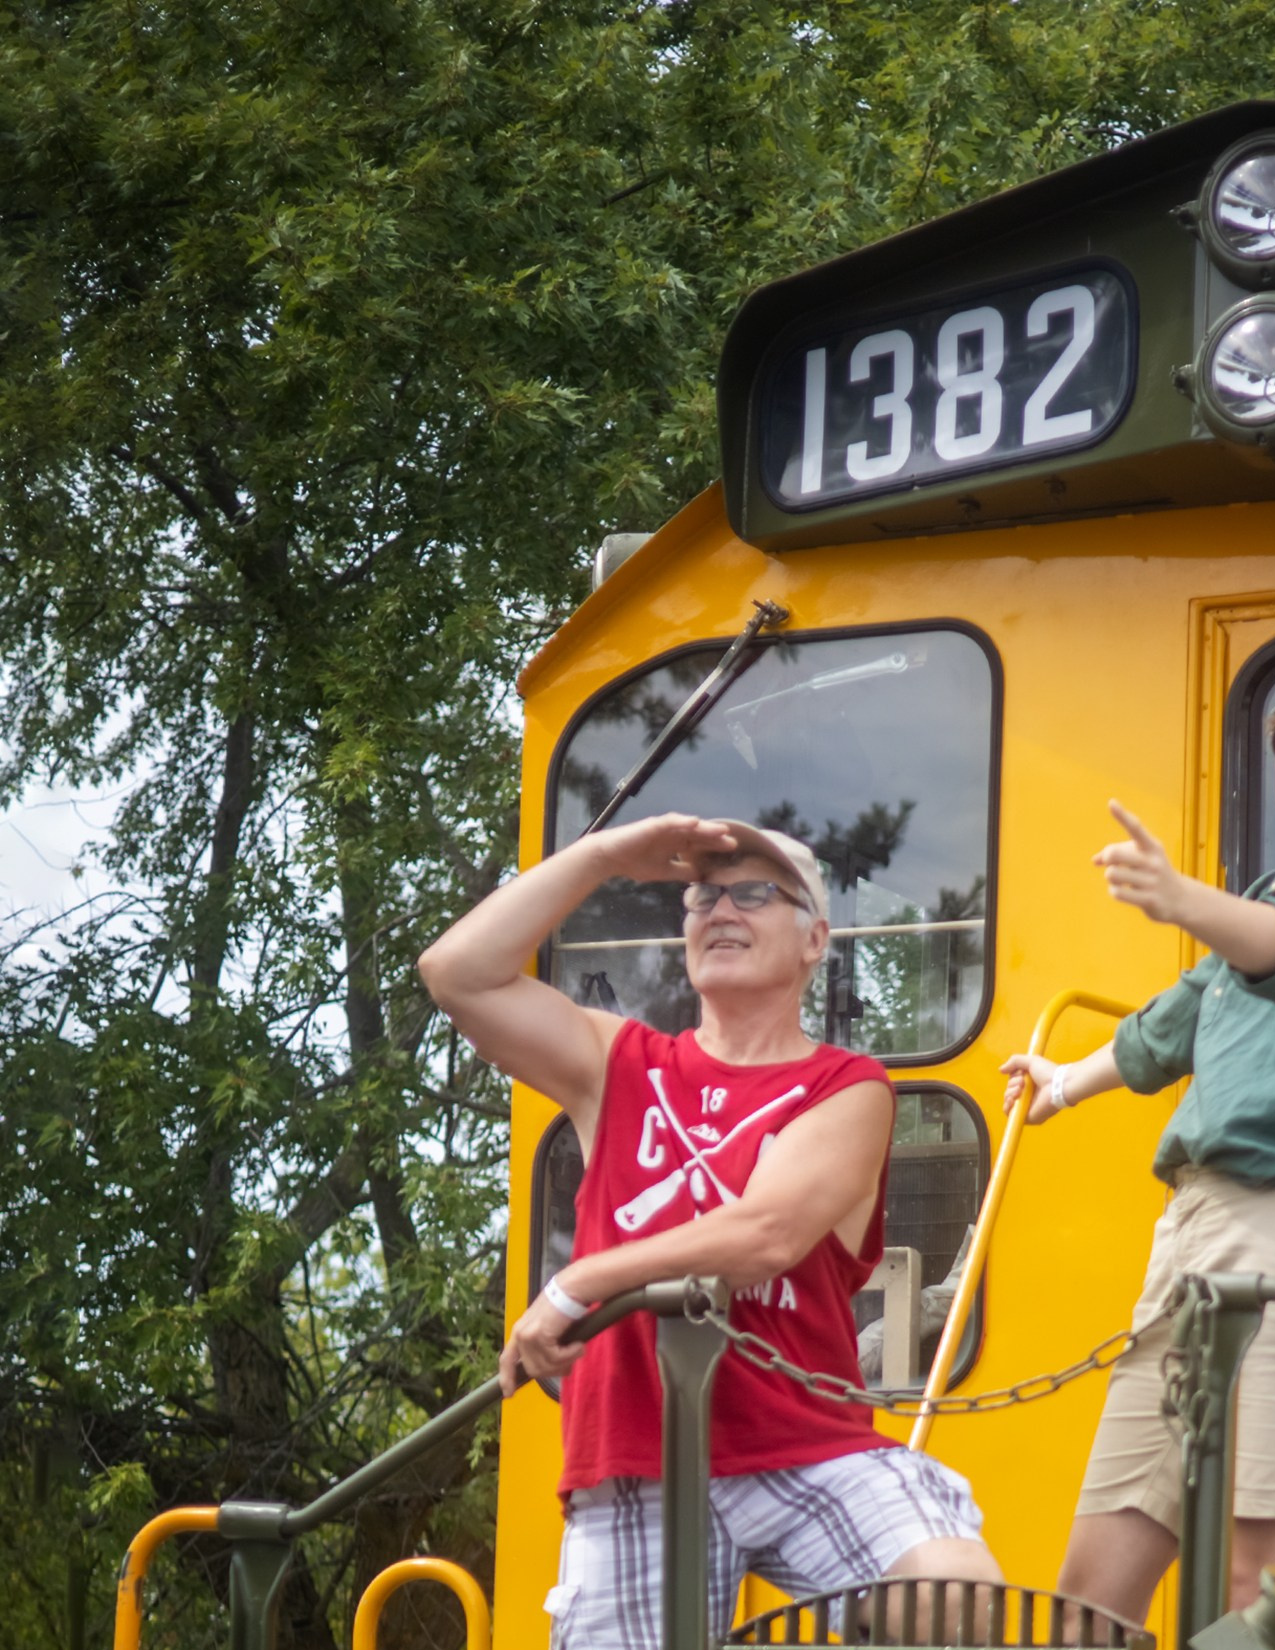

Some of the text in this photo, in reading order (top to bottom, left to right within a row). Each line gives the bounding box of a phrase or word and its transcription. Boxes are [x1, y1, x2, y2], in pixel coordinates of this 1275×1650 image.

[800, 284, 1096, 495] 1382
[700, 1085, 728, 1115] 18
[636, 1105, 667, 1169] C
